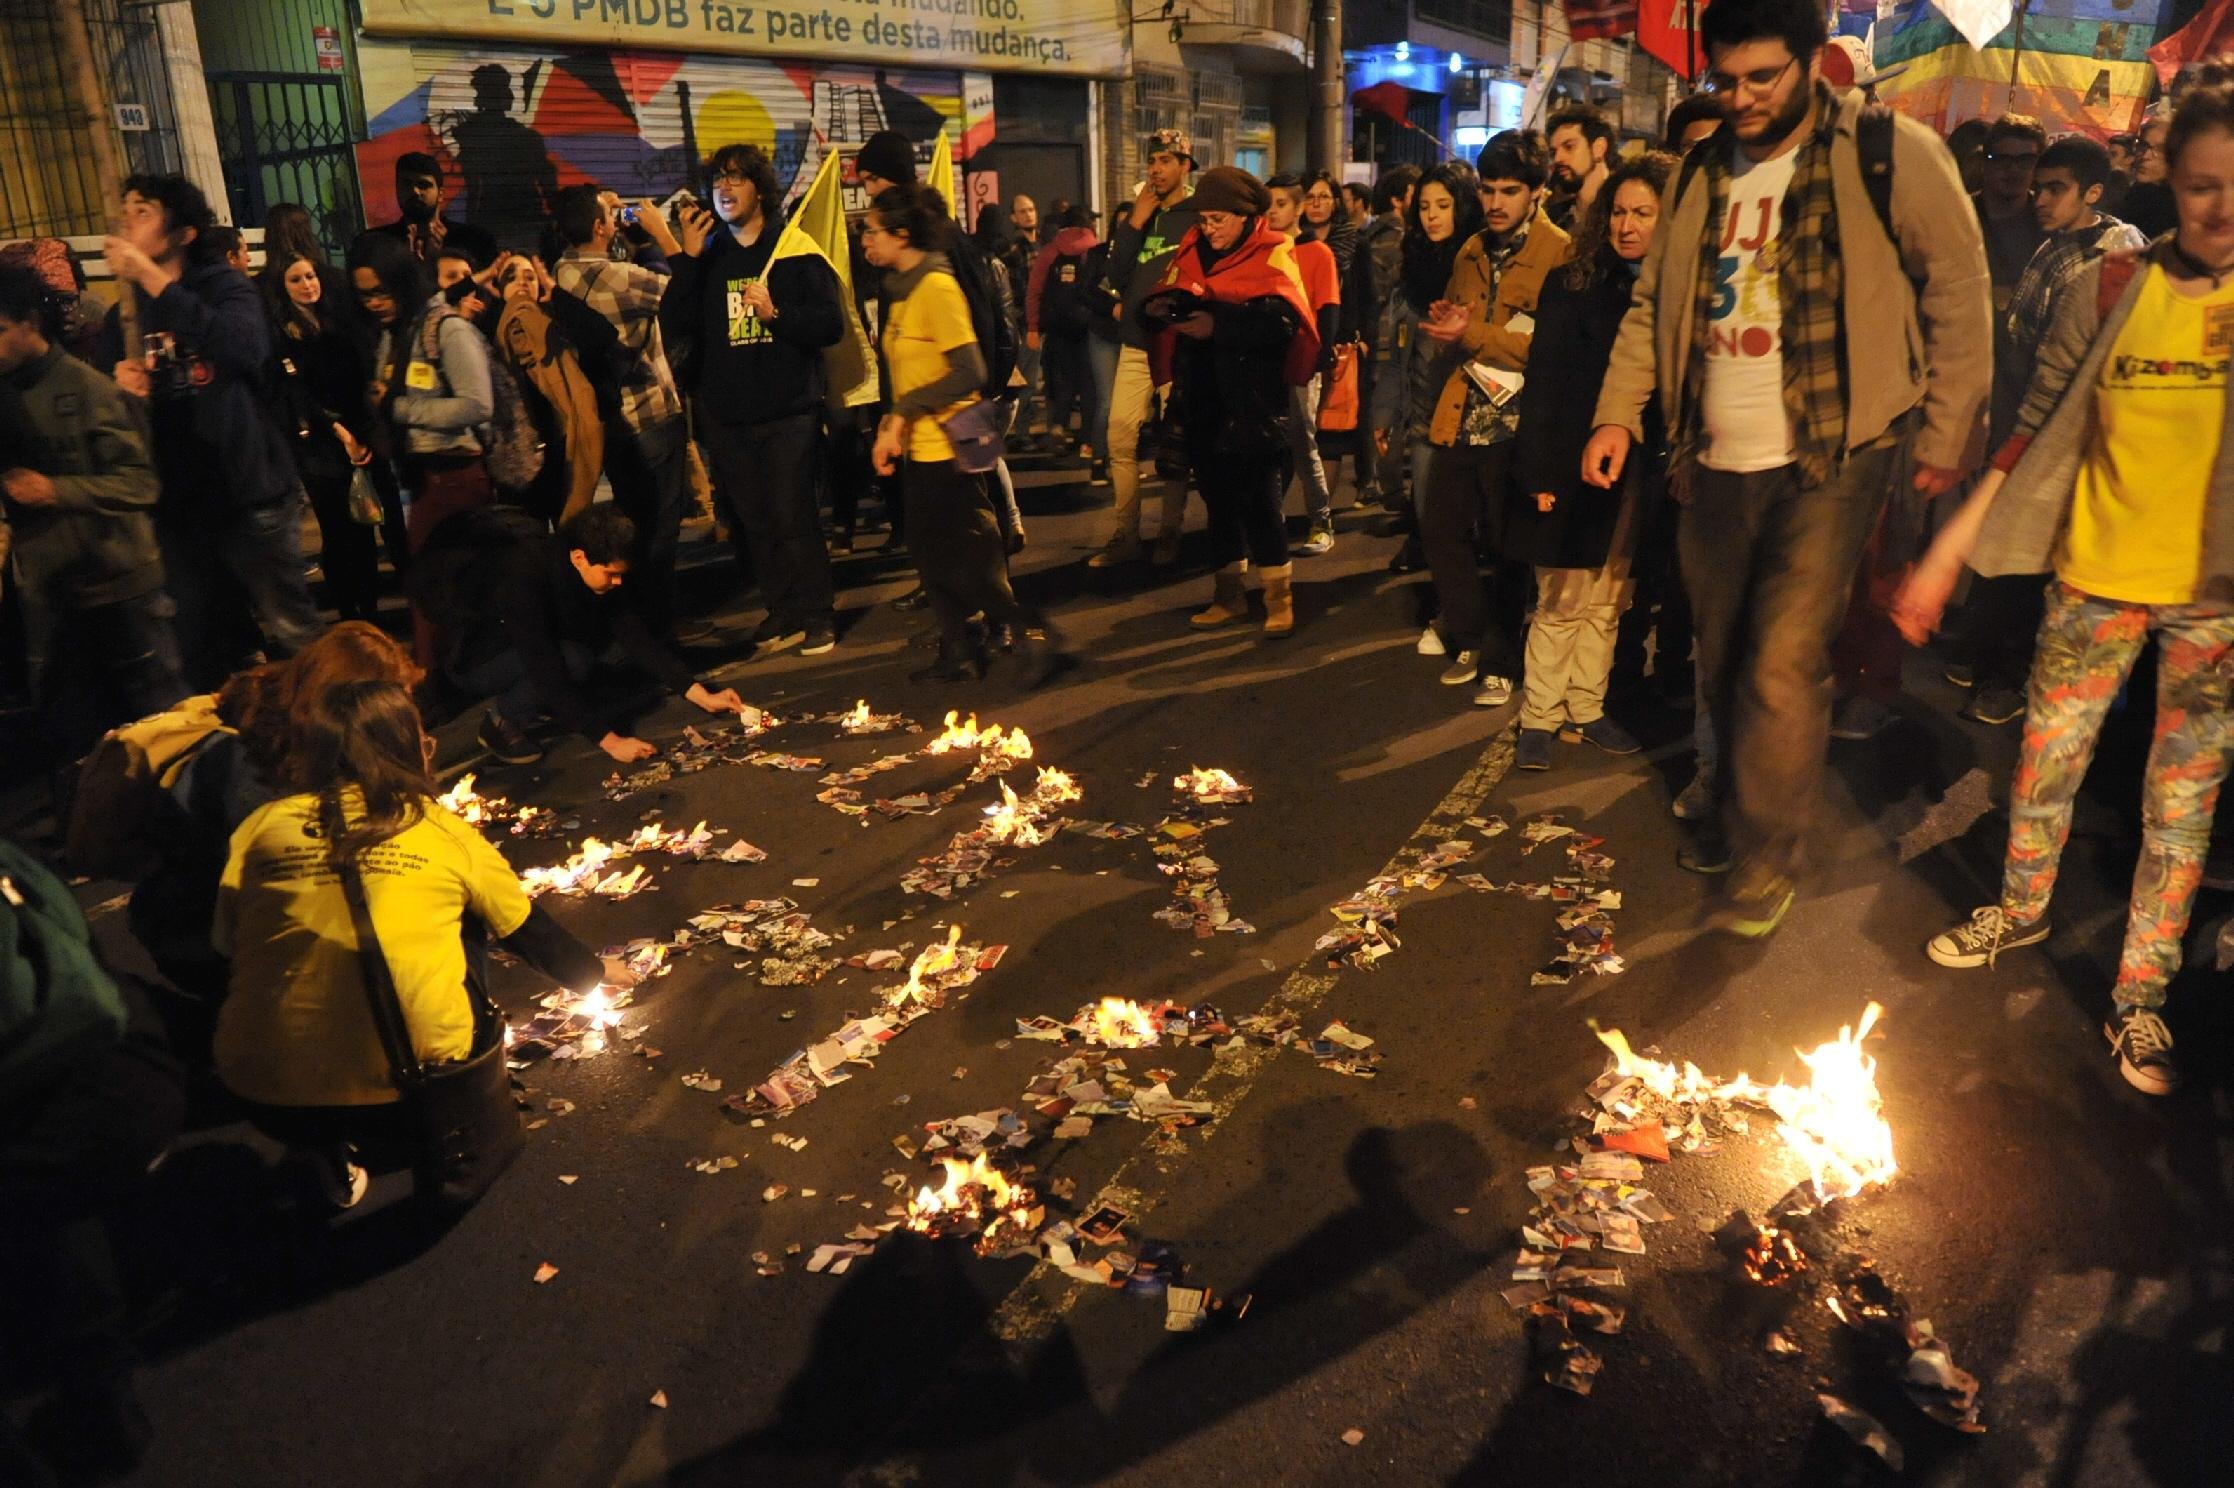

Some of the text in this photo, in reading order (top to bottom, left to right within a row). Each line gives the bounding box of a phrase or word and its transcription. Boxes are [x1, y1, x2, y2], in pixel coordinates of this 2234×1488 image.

[573, 0, 689, 28] PMDB
[701, 4, 755, 34] faz
[766, 9, 851, 43] parte
[863, 12, 941, 50] desta
[951, 26, 1071, 62] mudança.
